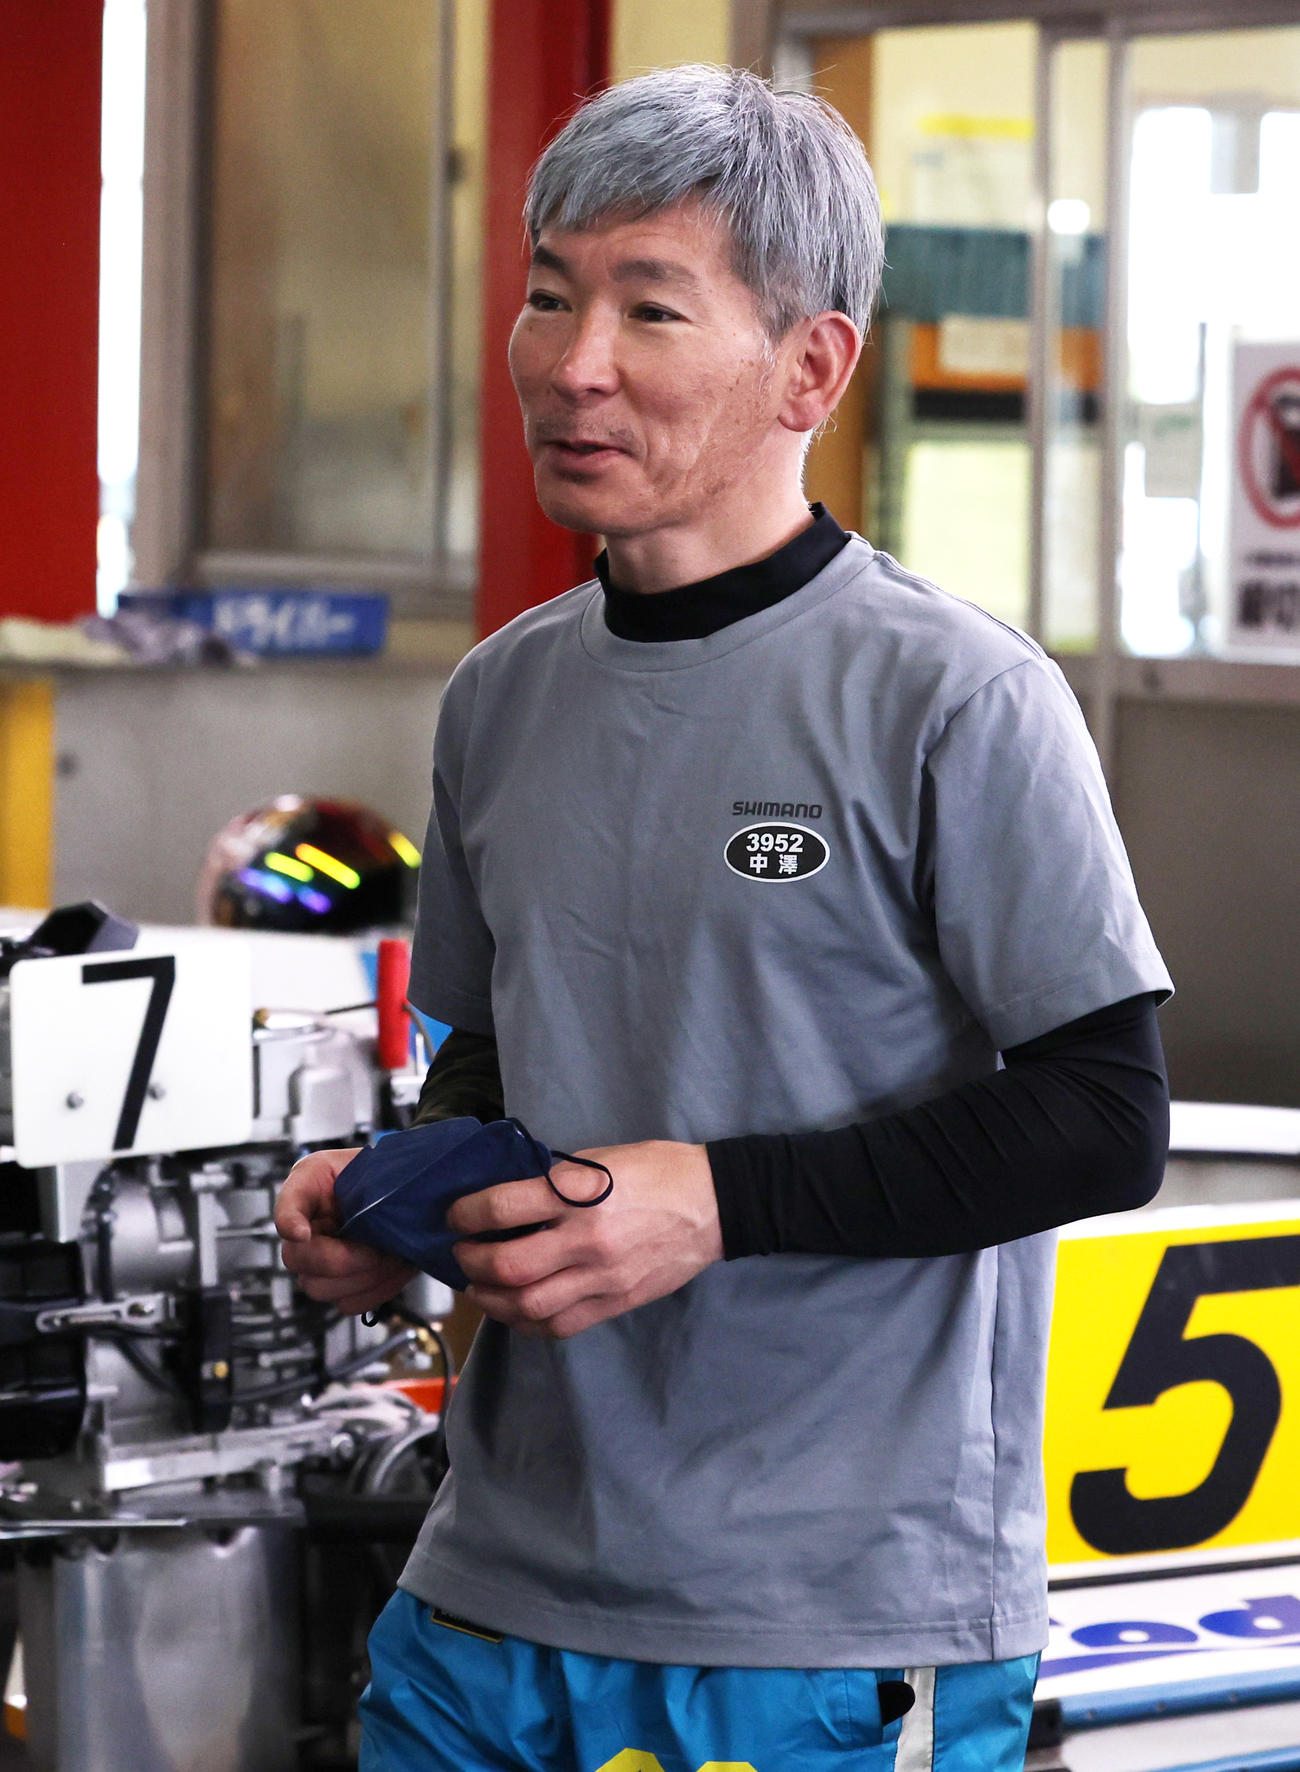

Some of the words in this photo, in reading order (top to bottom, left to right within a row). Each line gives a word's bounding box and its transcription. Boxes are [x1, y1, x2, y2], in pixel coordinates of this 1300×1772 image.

[732, 801, 823, 819] SHIMANO
[746, 833, 804, 853] 3952
[82, 955, 176, 1152] 7
[1069, 1234, 1300, 1556] 5
